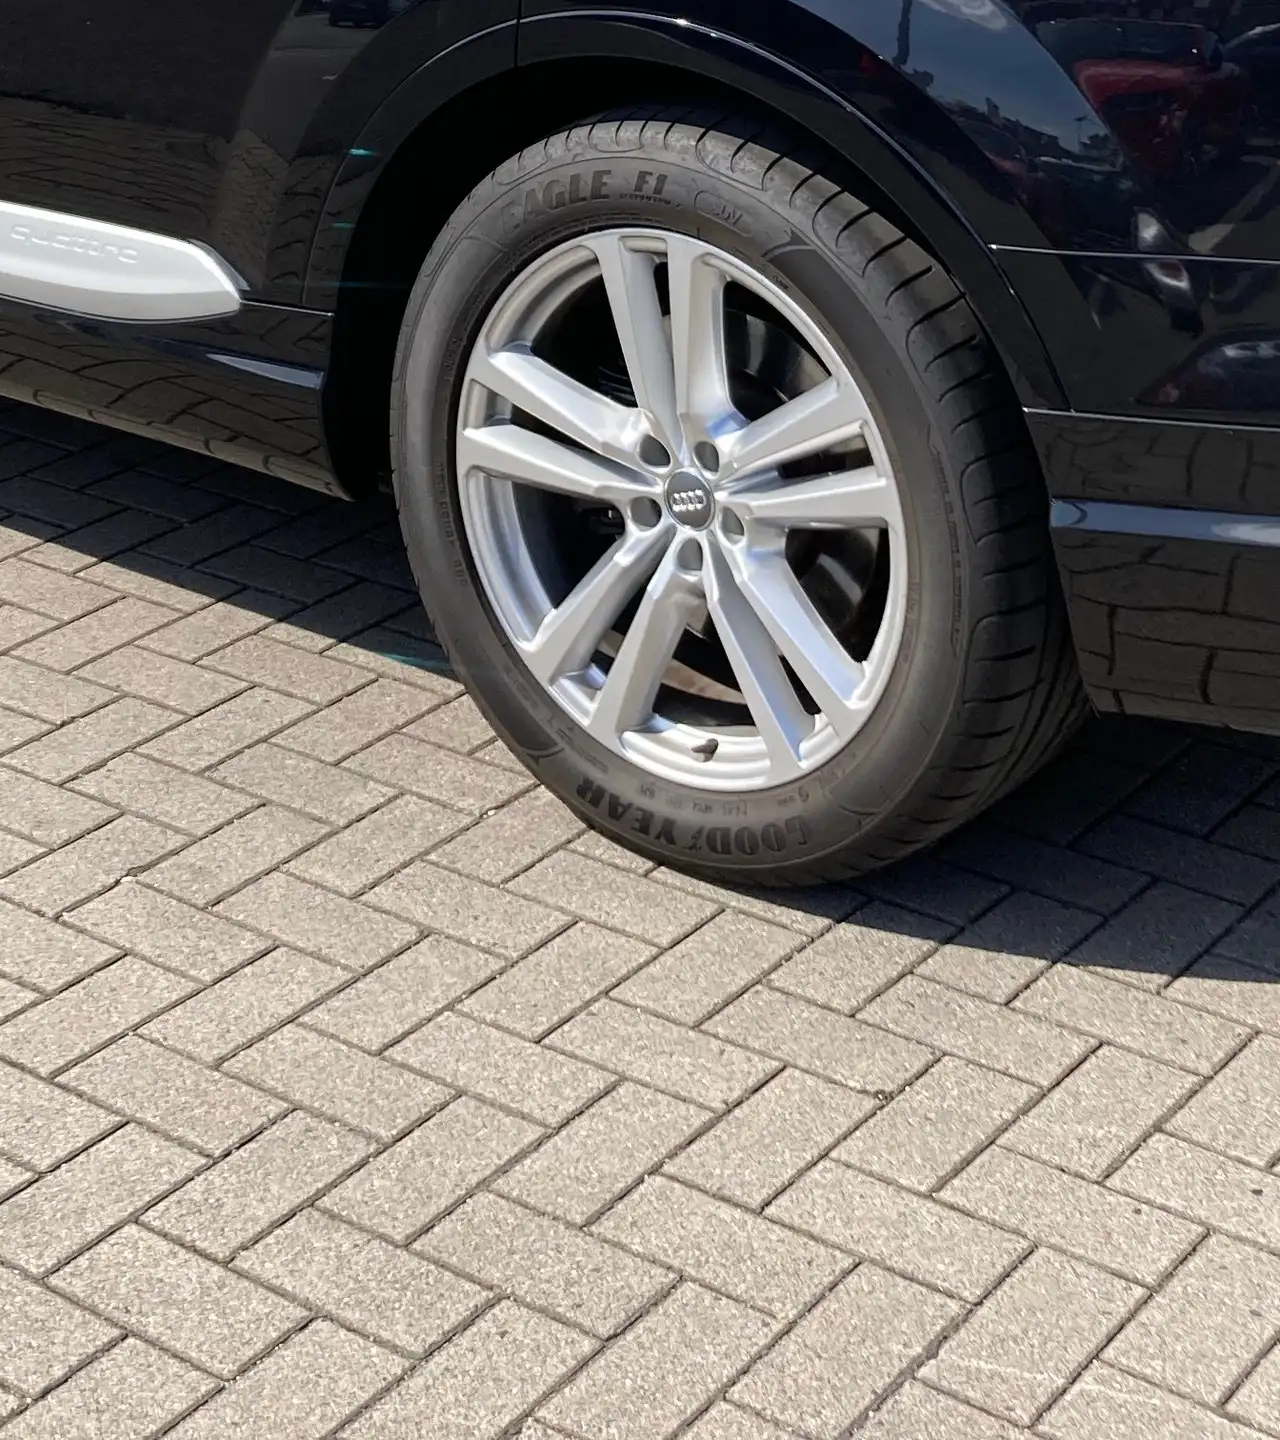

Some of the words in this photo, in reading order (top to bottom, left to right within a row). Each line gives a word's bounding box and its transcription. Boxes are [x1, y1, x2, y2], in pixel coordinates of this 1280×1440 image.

[499, 169, 613, 236] EAGLE
[632, 170, 669, 196] F1
[576, 775, 812, 857] GOODYEAR
